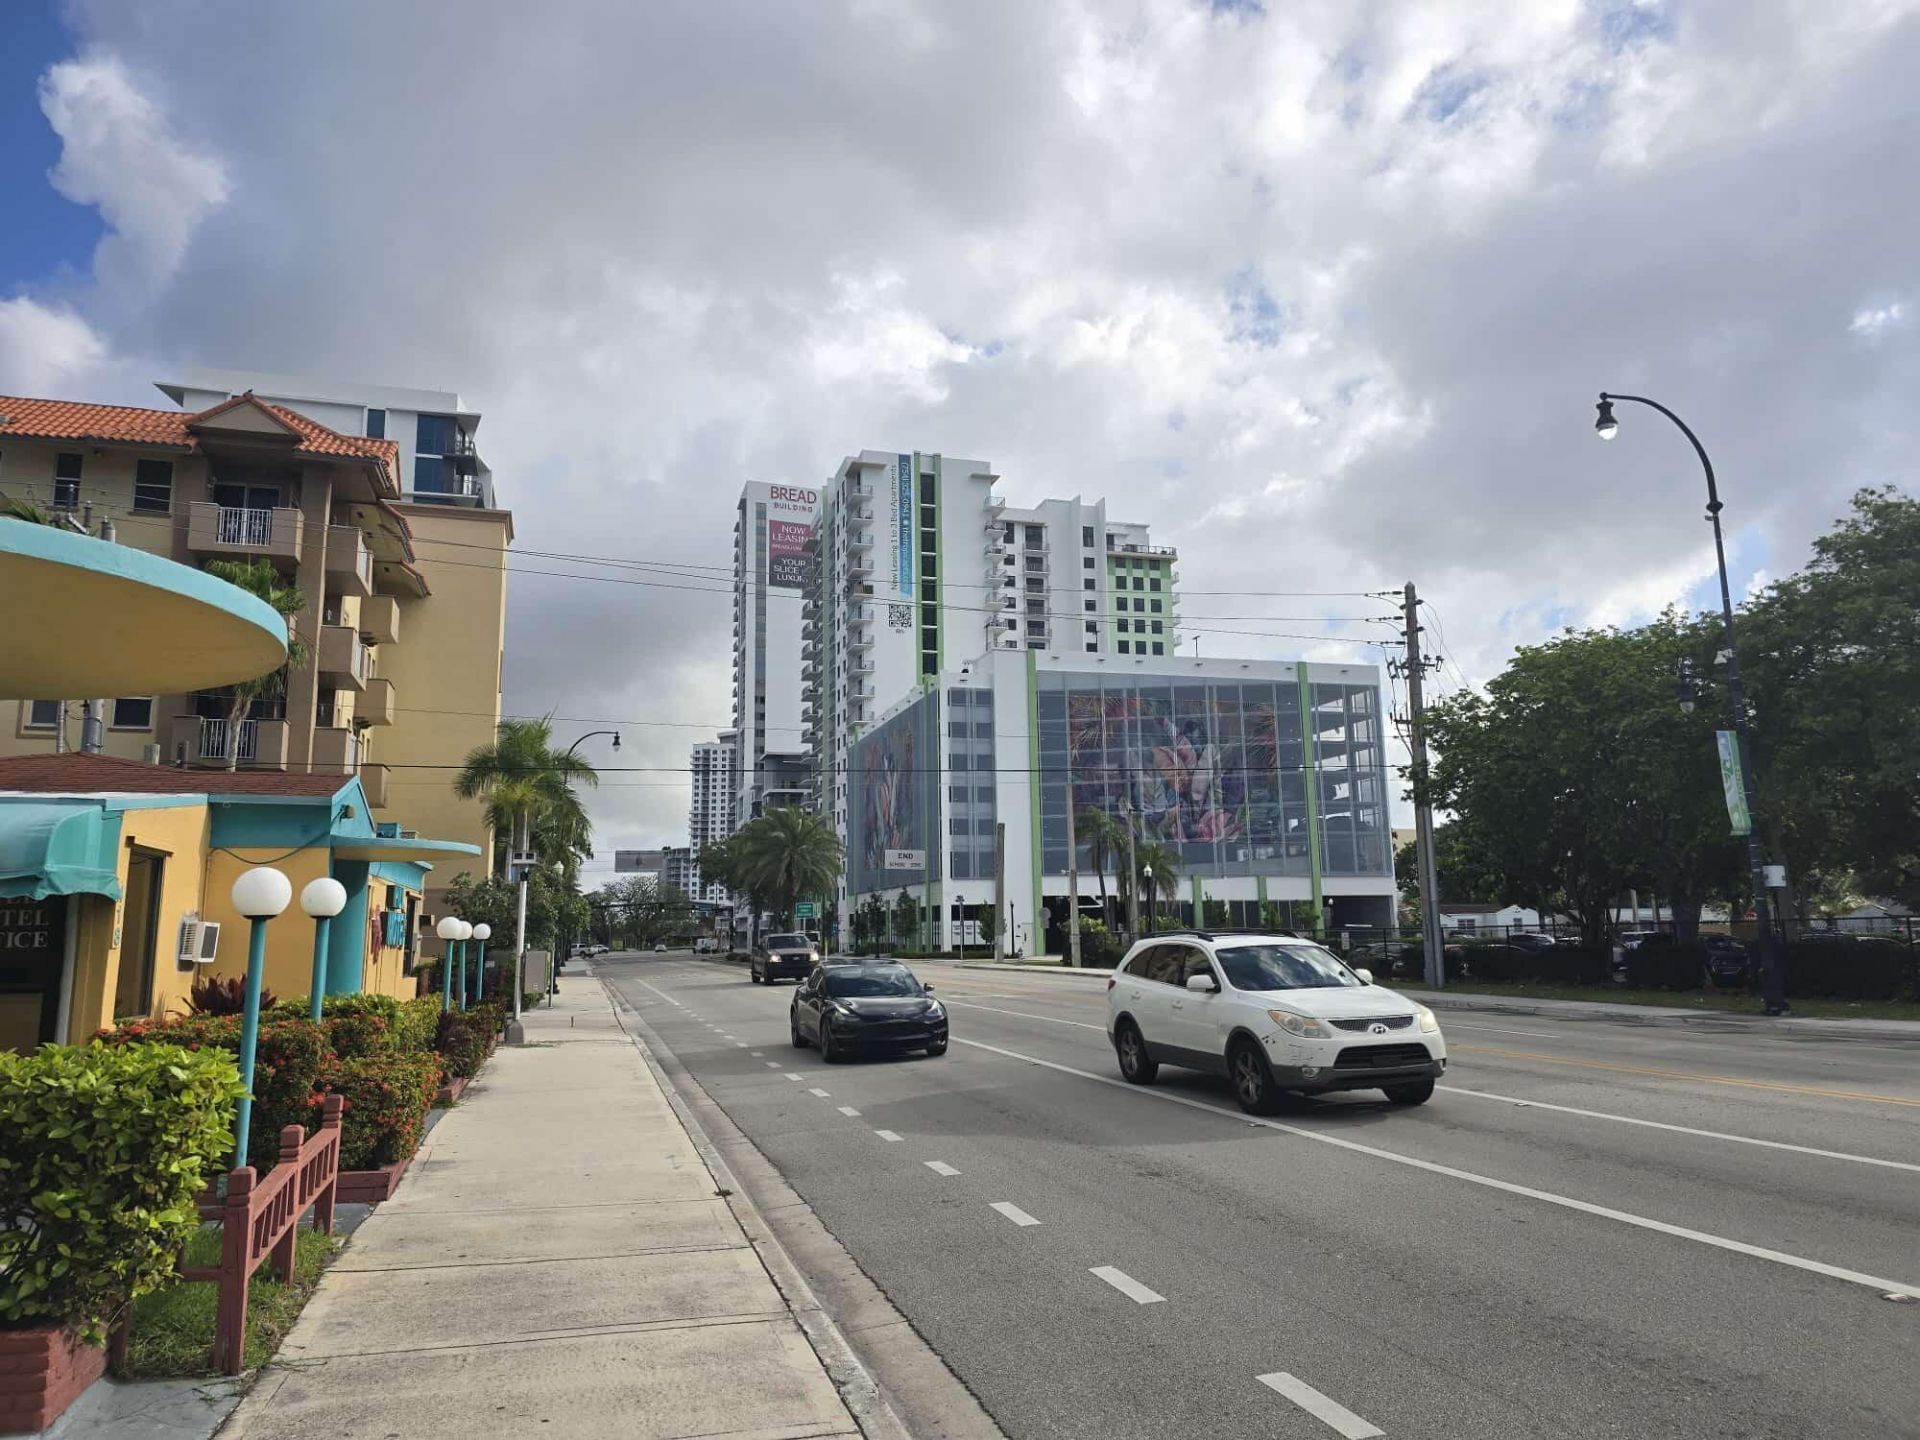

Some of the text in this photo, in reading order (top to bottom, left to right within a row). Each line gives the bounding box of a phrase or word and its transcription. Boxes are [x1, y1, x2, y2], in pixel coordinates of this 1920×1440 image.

[890, 464, 898, 508] Apartments
[771, 485, 817, 504] BREAD
[774, 501, 813, 513] BUILDING
[781, 525, 806, 535] NOW
[890, 530, 897, 538] to
[772, 531, 808, 543] LEASIN
[890, 544, 898, 571] Leasing
[773, 564, 800, 575] SLICE
[890, 572, 898, 591] Now
[897, 852, 914, 860] END
